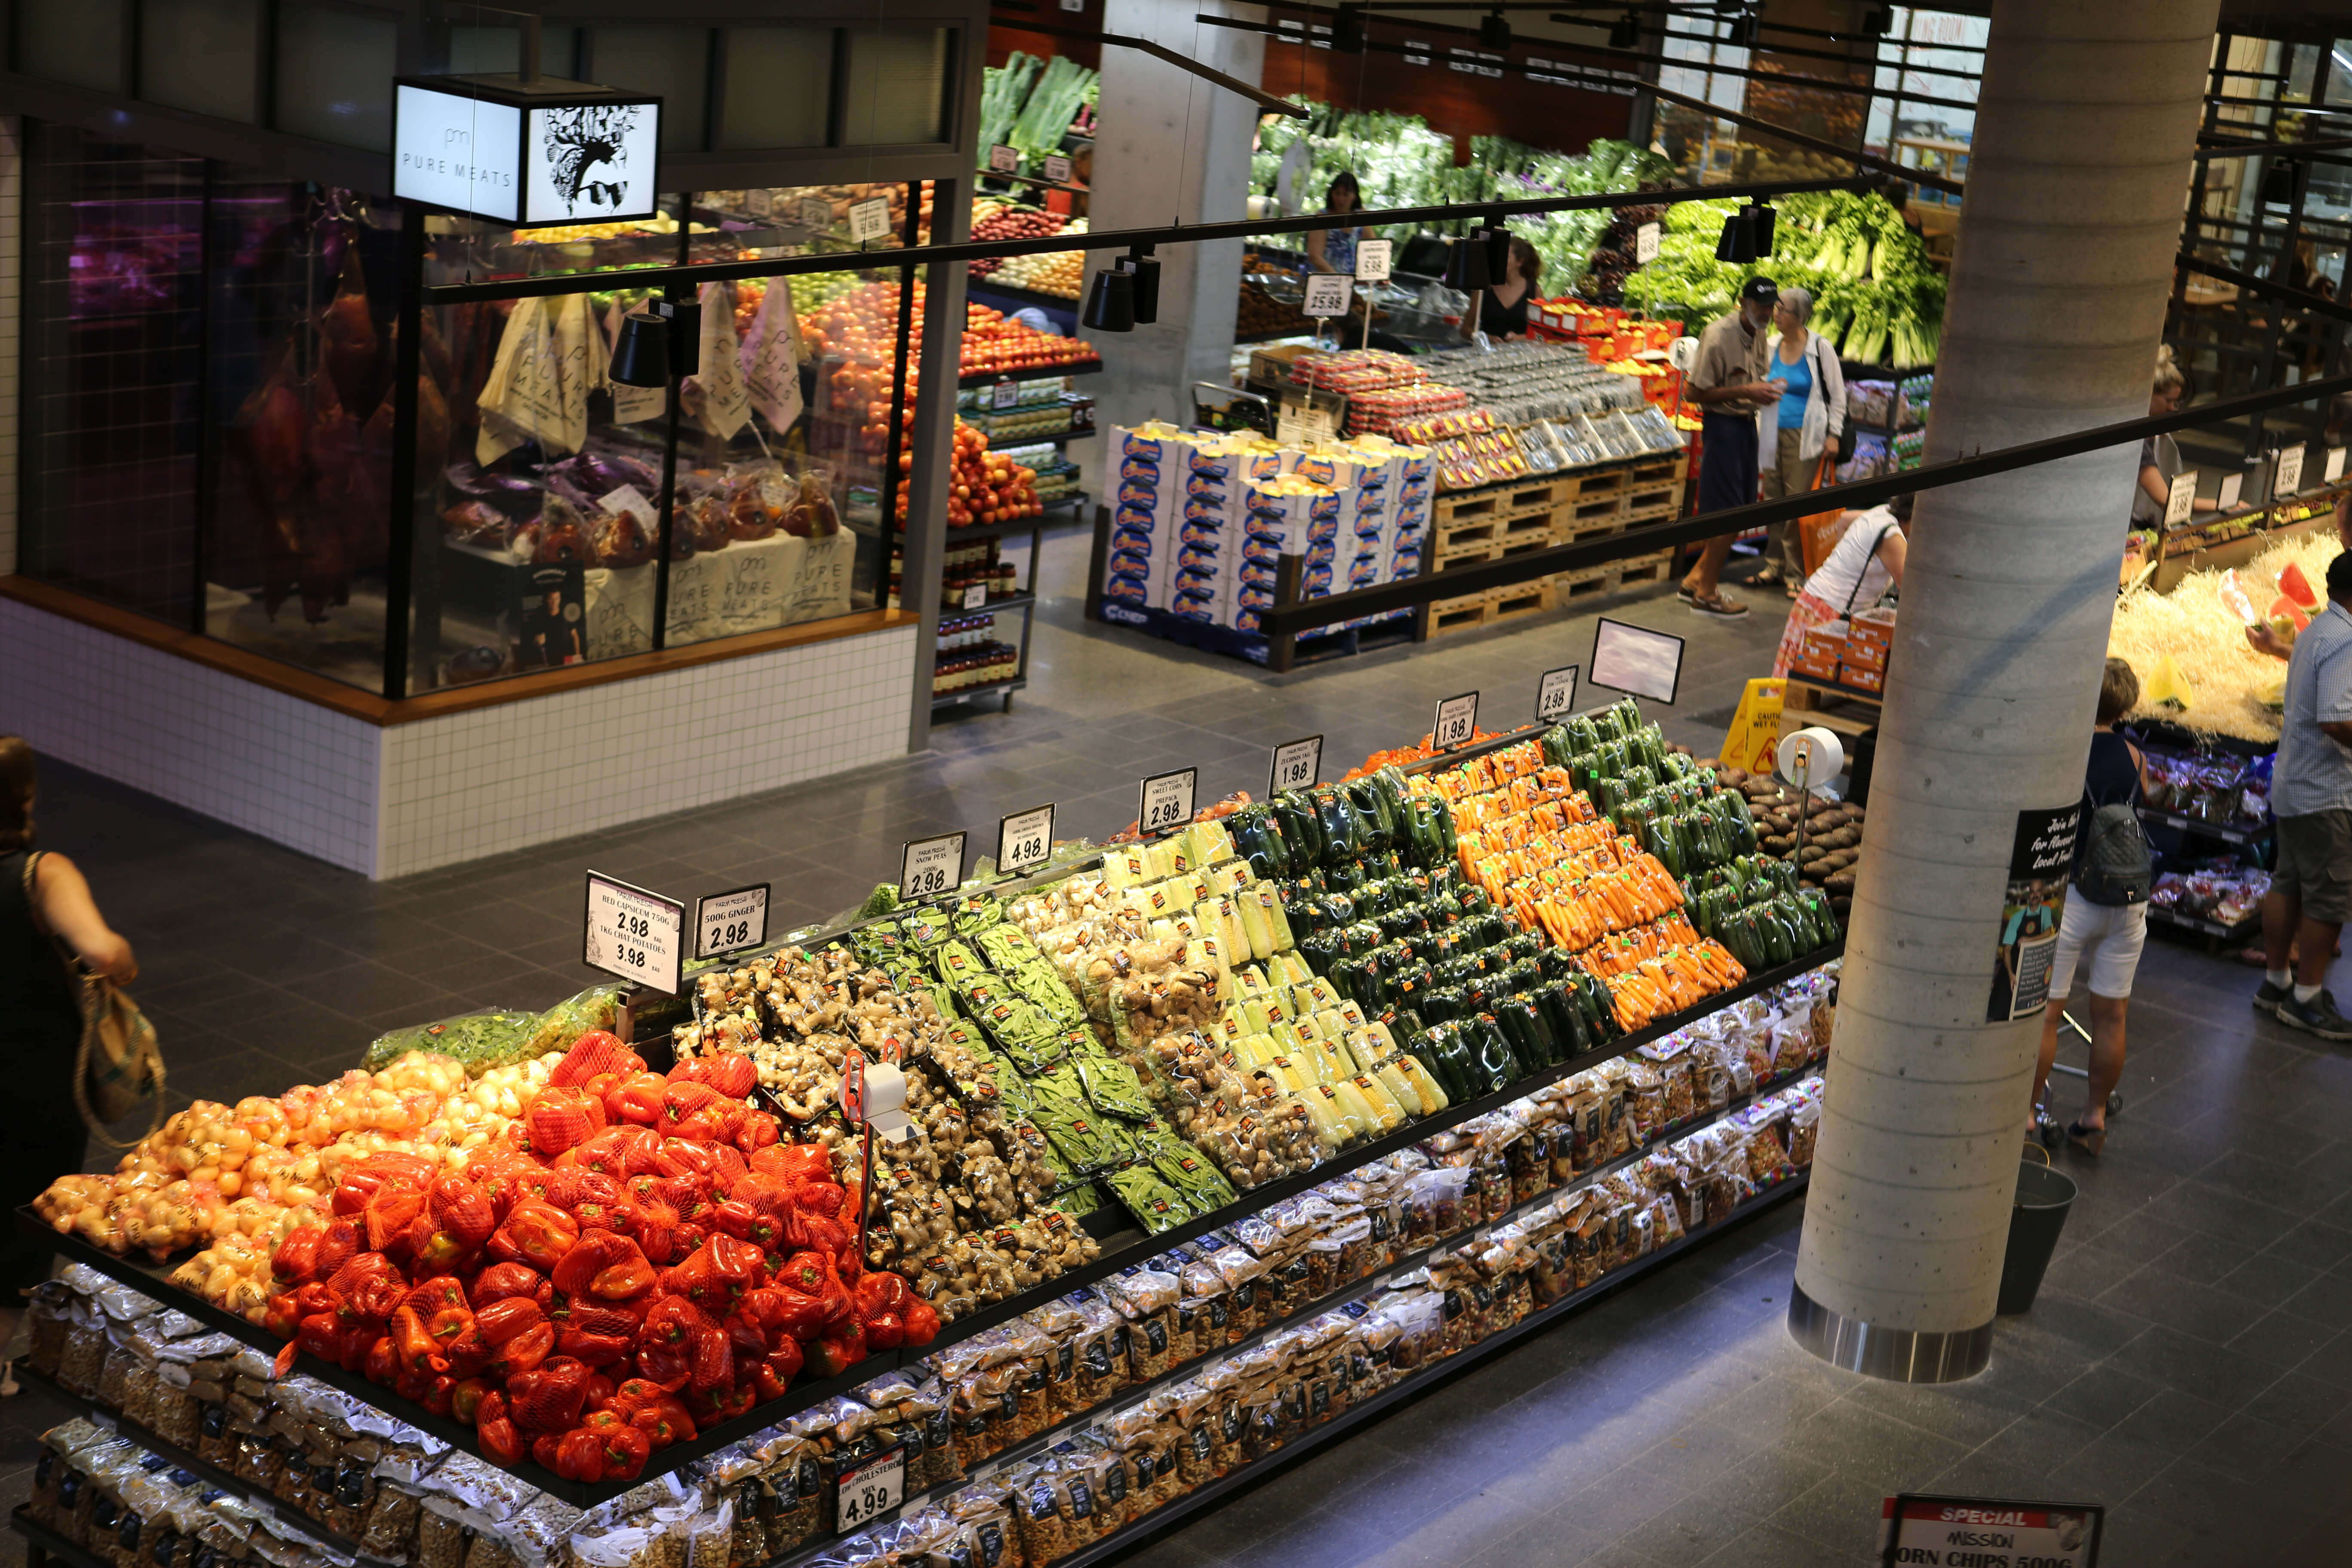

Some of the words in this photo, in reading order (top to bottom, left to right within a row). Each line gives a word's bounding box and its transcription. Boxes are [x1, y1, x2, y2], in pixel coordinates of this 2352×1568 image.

[403, 153, 445, 174] PURE
[455, 163, 511, 187] MEATS
[673, 584, 710, 604] URE
[725, 581, 772, 596] PURE
[670, 601, 709, 620] EATS
[1544, 690, 1565, 711] 2.98
[1442, 718, 1466, 742] 1.98
[1753, 720, 1767, 729] WET
[1283, 761, 1308, 784] 1.98
[1152, 786, 1168, 796] SWEET
[1169, 782, 1182, 792] CORN
[1155, 794, 1178, 805] PREPACK
[1151, 800, 1180, 826] 2.98
[915, 854, 932, 864] SNOW
[933, 852, 947, 861] PEAS
[1011, 837, 1041, 863] 4.98
[922, 865, 938, 874] 200G
[910, 869, 945, 895] 2.98
[602, 894, 615, 906] RED
[617, 901, 649, 918] CAPSICUM
[652, 913, 670, 925] 750G
[616, 890, 633, 903] FARM
[633, 897, 653, 910] FRESH
[715, 899, 731, 909] FARM
[730, 896, 747, 906] FRESH
[704, 913, 726, 924] 500G
[728, 904, 755, 919] GINGER
[617, 912, 649, 938] 2.98
[710, 920, 748, 949] 2.98
[600, 925, 612, 936] 1KG
[614, 931, 630, 943] CHAT
[632, 937, 666, 955] POTATOES
[616, 943, 646, 968] 3.98
[184, 1277, 202, 1290] Net
[236, 1283, 252, 1297] 1kg
[852, 1458, 903, 1487] CHOLESTEROL
[861, 1485, 876, 1496] MIX
[845, 1487, 888, 1522] 4.99
[1939, 1507, 2027, 1527] SPECIAL
[1947, 1530, 2015, 1550] MISSION
[1896, 1547, 1939, 1565] ORN
[1945, 1550, 2009, 1568] CHIPS
[2015, 1556, 2073, 1568] 500G
